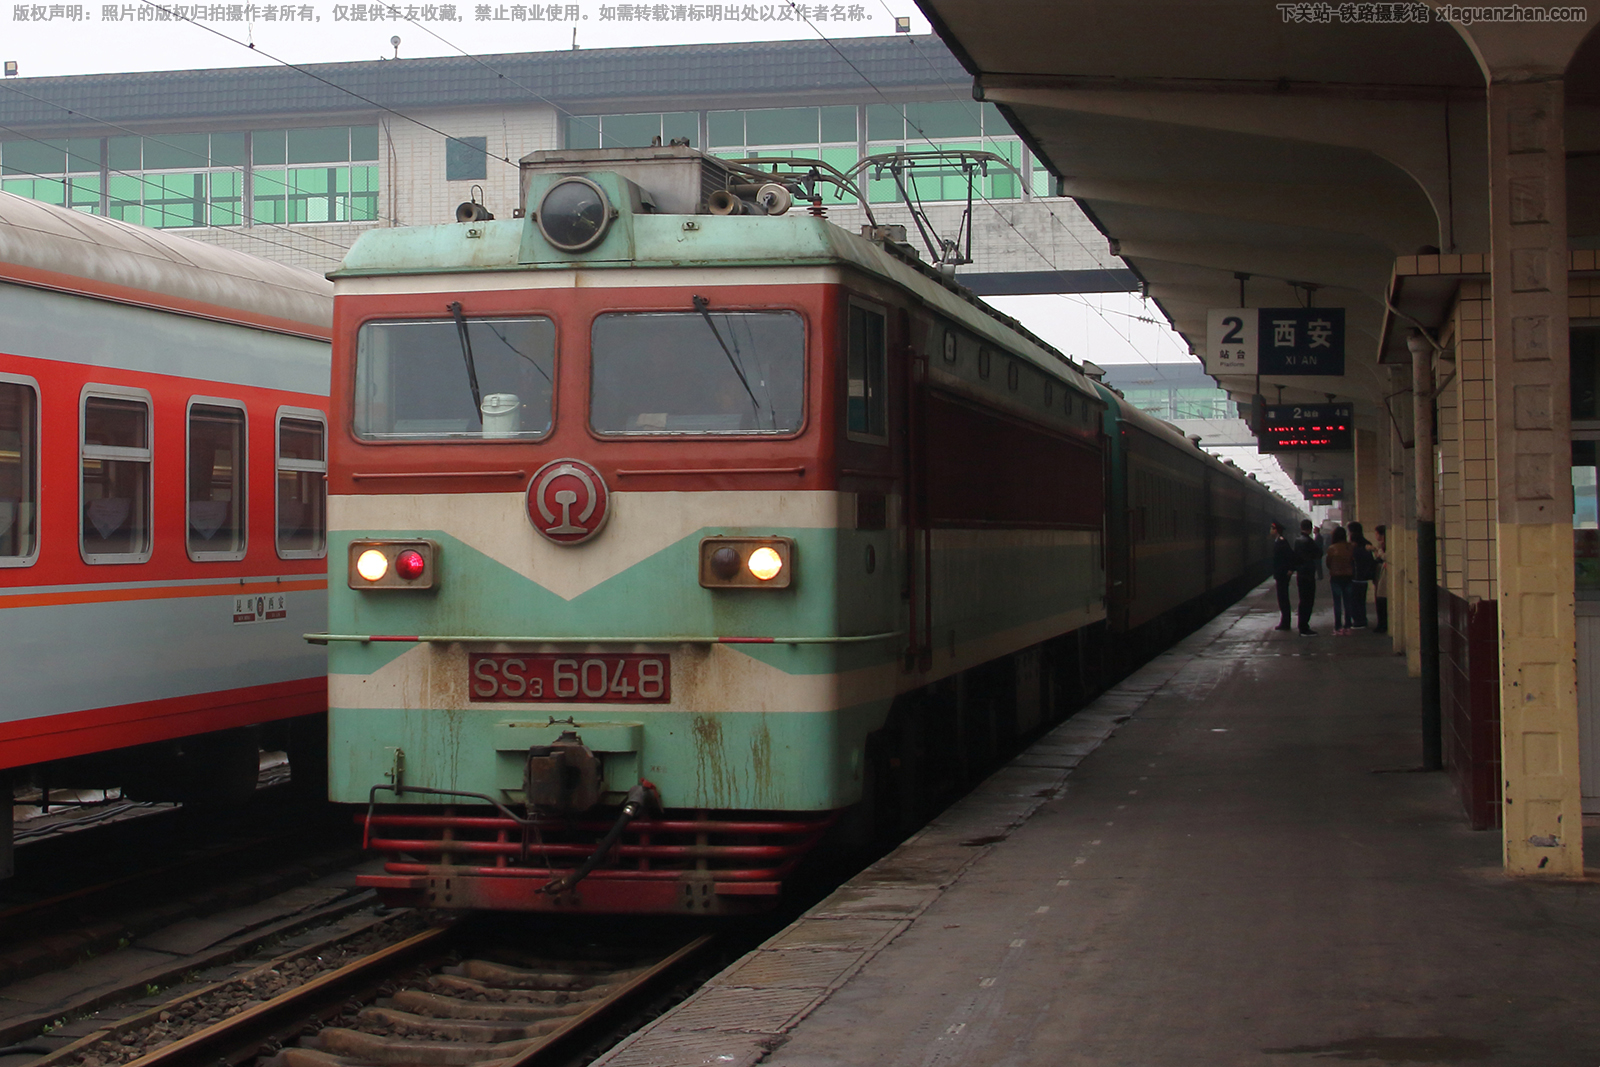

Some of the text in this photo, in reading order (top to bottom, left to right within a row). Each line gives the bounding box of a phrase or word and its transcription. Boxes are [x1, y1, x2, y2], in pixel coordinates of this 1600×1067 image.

[1221, 316, 1244, 344] 2
[1272, 318, 1332, 349] 西安
[1219, 349, 1246, 360] 站台
[1293, 407, 1302, 419] 2
[553, 658, 664, 699] 6048
